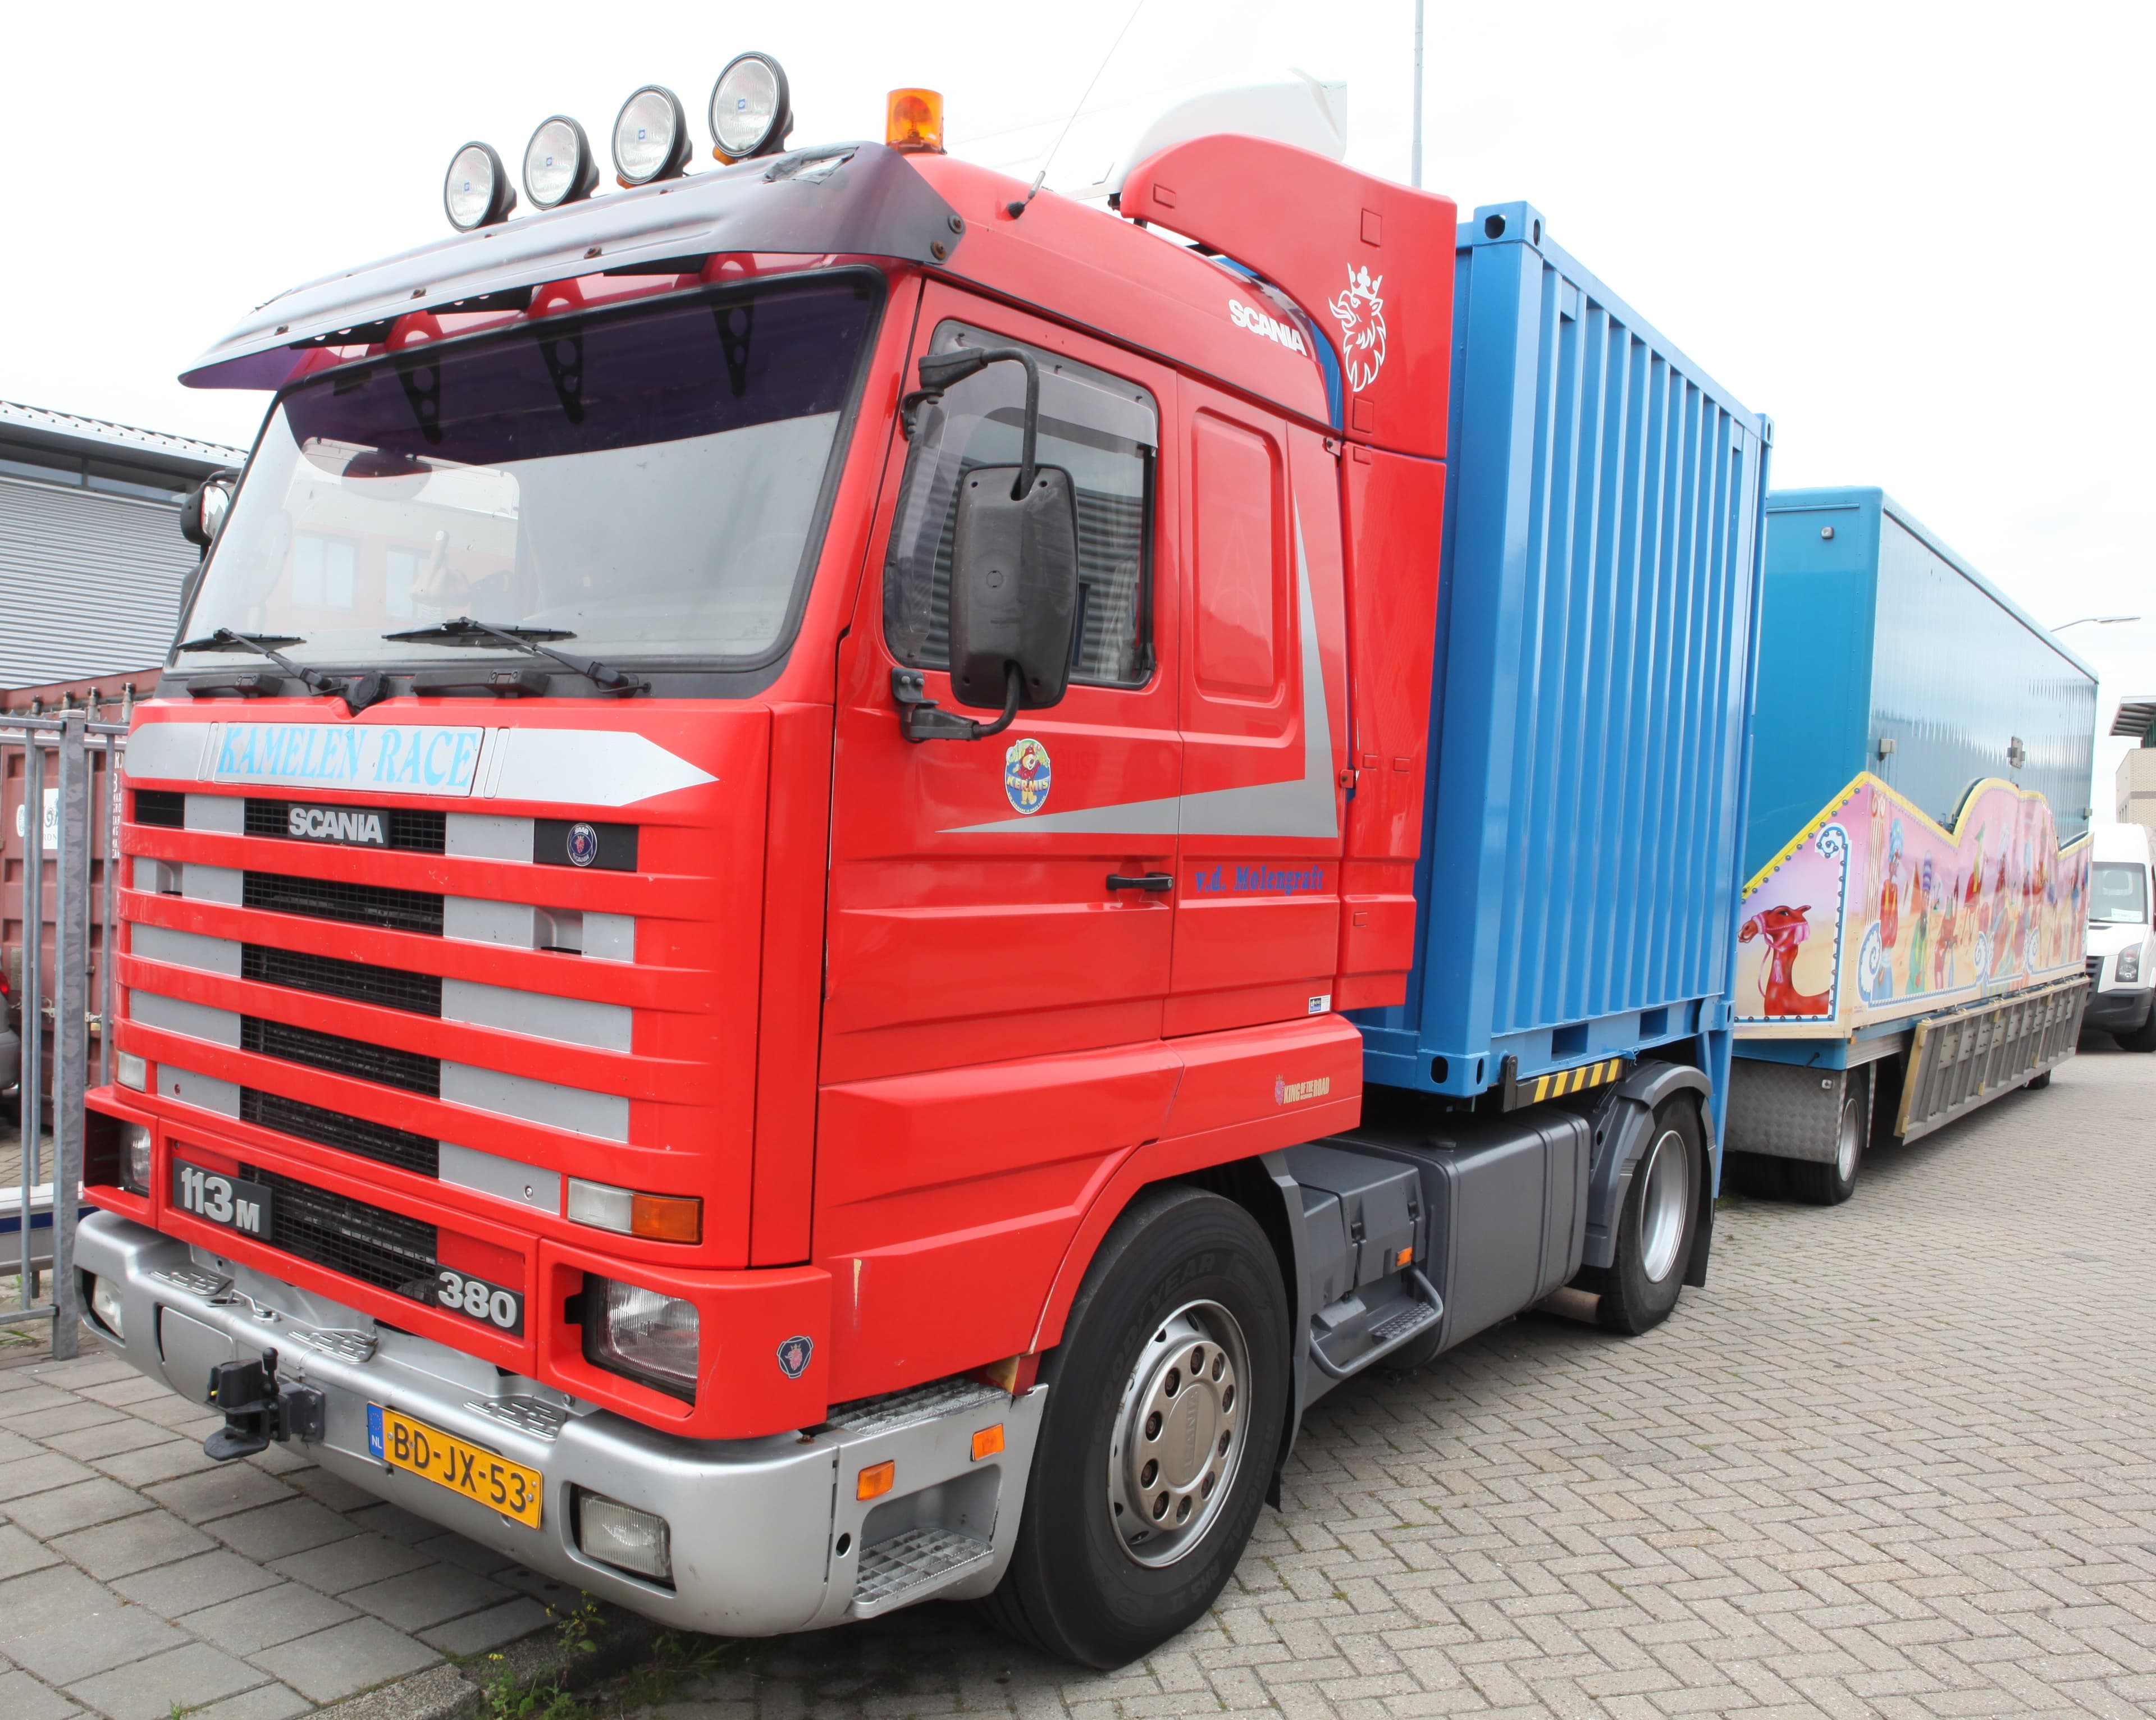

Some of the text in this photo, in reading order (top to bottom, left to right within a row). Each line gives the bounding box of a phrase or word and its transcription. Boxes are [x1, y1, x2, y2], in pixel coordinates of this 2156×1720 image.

[1228, 299, 1307, 356] SCANIA
[217, 726, 476, 786] KAMELEN RACE
[1007, 776, 1049, 792] KERMIS
[289, 808, 383, 843] SCANIA
[574, 826, 589, 835] SAAB
[1195, 864, 1323, 896] v.d. Molengraft
[1283, 1083, 1300, 1104] KING
[1313, 1077, 1330, 1097] ROAD
[181, 1167, 260, 1233] 113 M
[438, 1271, 517, 1328] 380
[371, 1434, 382, 1449] NL
[394, 1421, 527, 1513] BD-JX-53
